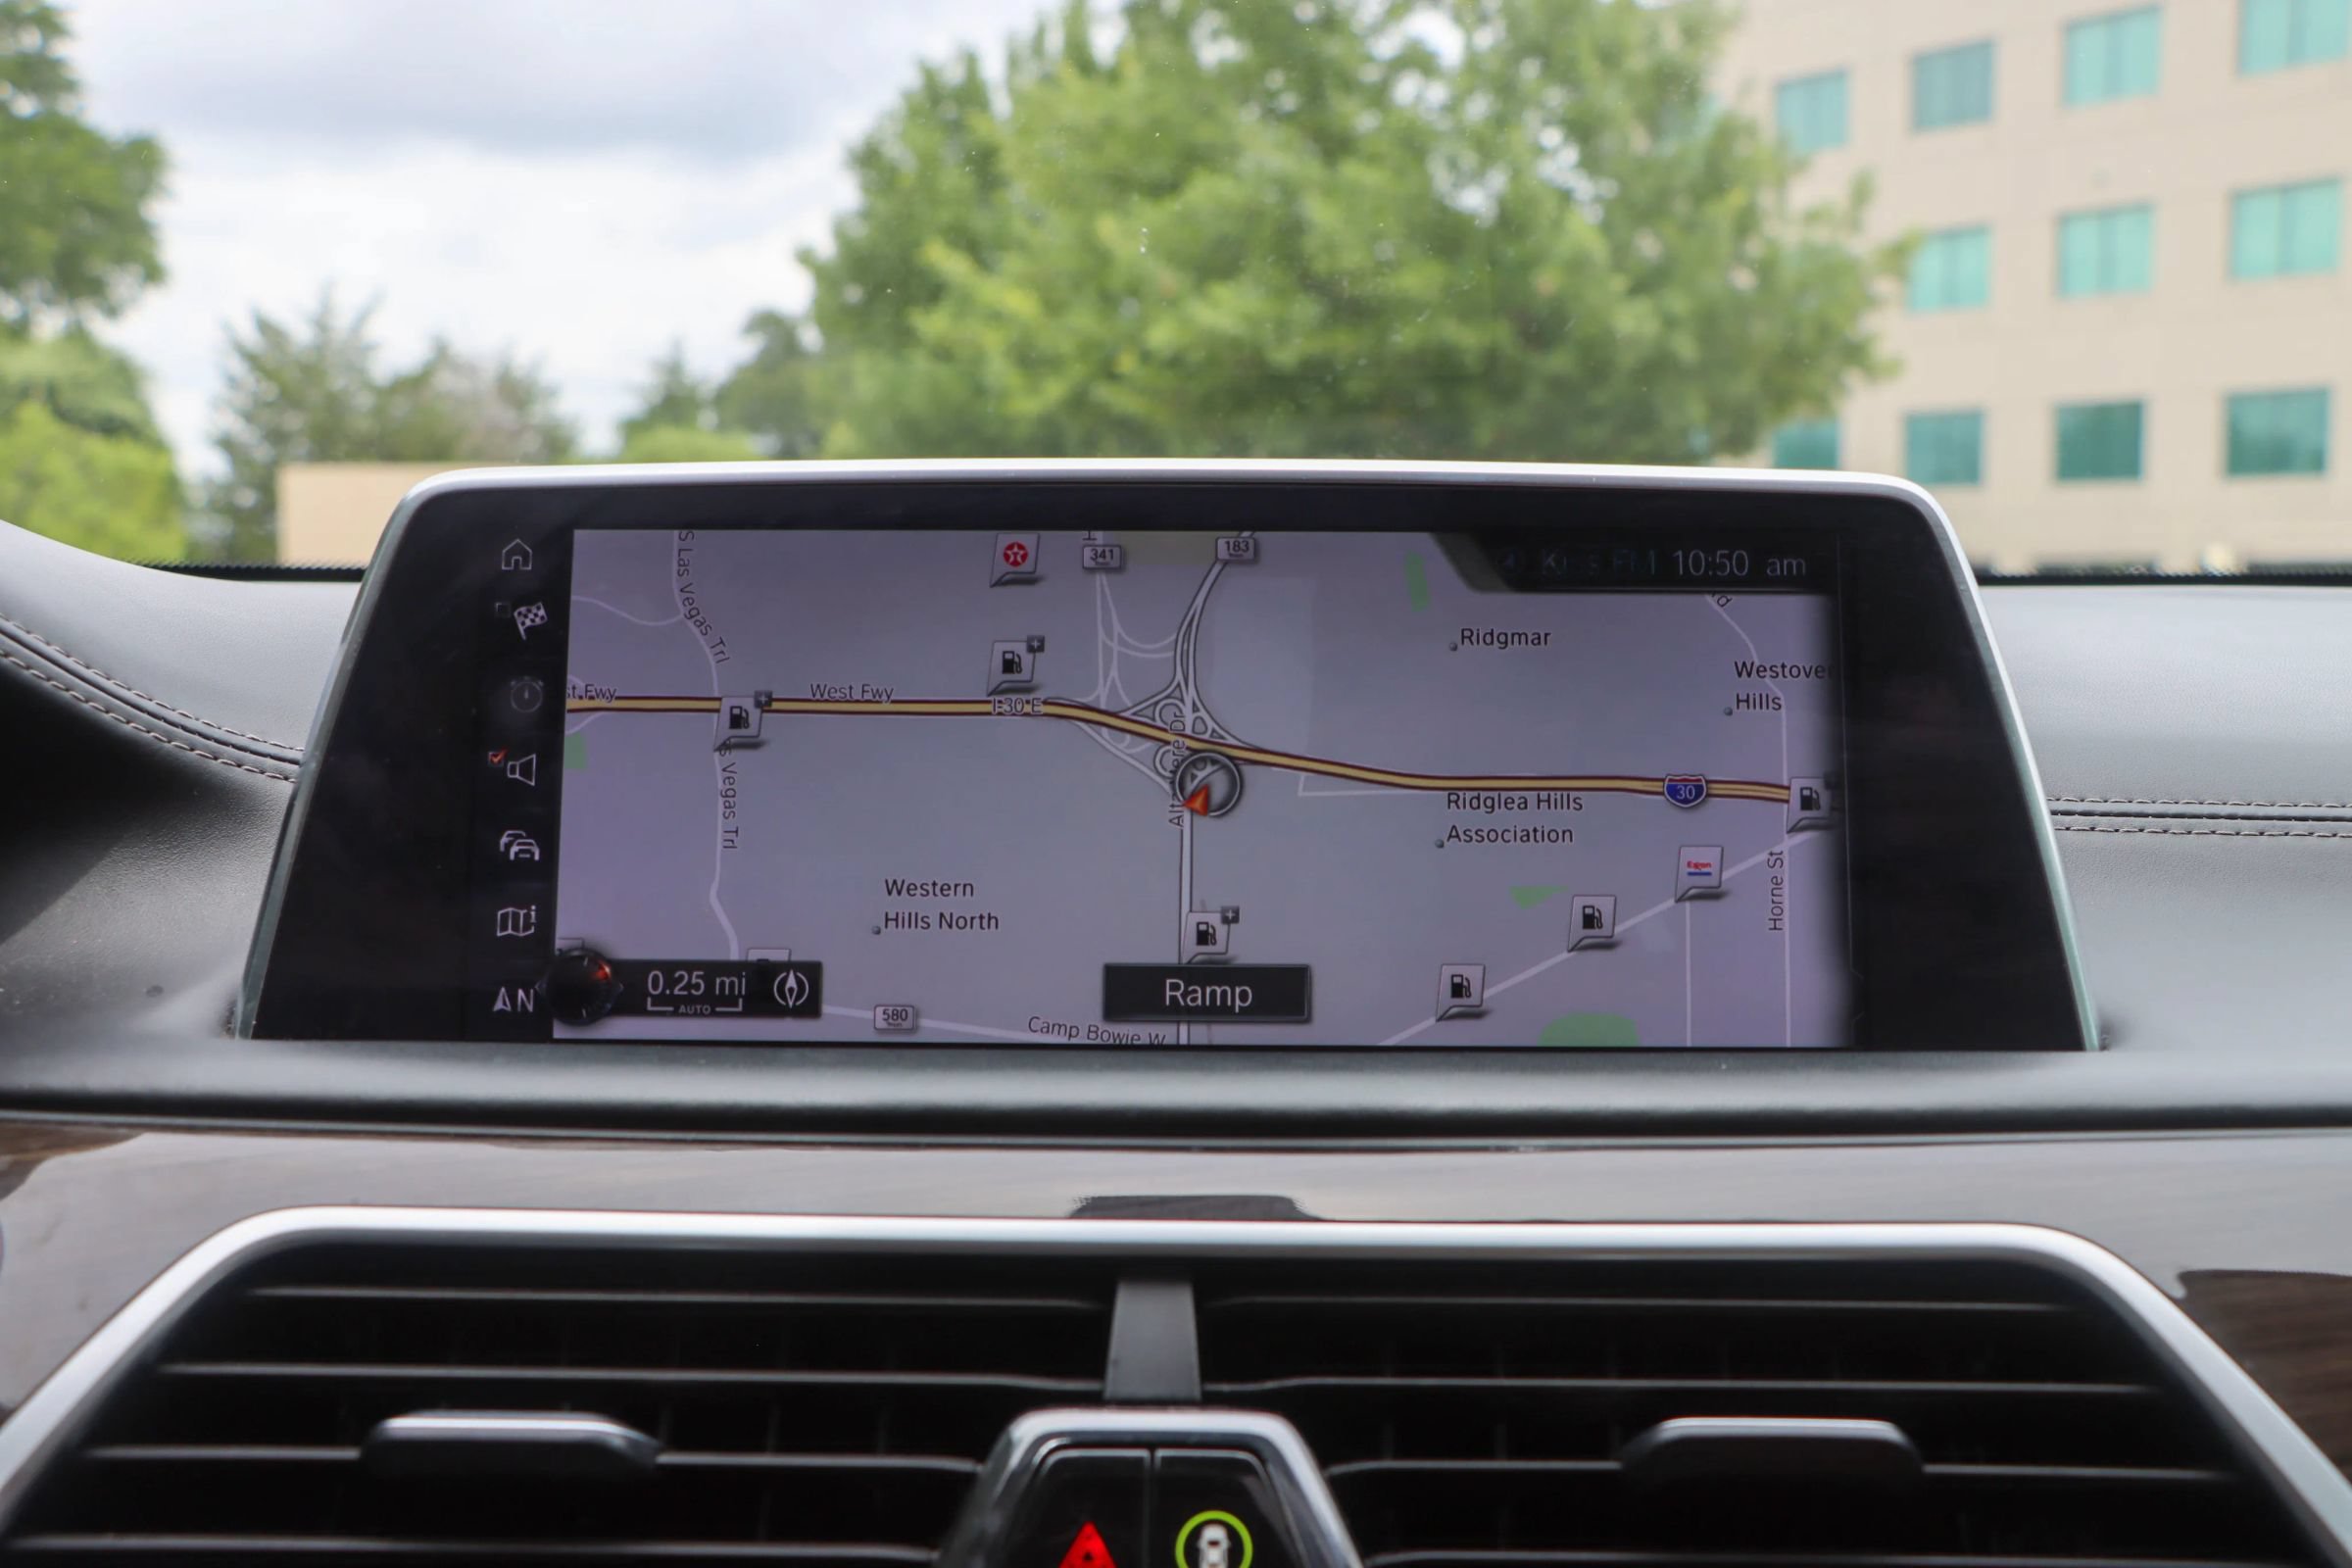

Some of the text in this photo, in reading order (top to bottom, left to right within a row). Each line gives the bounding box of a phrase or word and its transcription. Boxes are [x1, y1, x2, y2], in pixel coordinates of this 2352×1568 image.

[1090, 547, 1115, 562] 341
[1224, 539, 1250, 554] 183
[676, 548, 694, 577] Las
[1672, 549, 1806, 577] 10:50 am
[679, 582, 713, 637] Vegas
[1461, 627, 1550, 649] Ridgmar
[710, 636, 731, 663] Trl
[585, 684, 617, 704] Fwy
[810, 683, 894, 704] West Fwy
[1736, 693, 1782, 710] Hills
[1031, 698, 1042, 714] E
[1169, 711, 1186, 827] Altaere Dr
[720, 762, 737, 819] Vegas
[1677, 786, 1695, 801] 30
[1446, 792, 1583, 815] Ridglea Hills
[723, 826, 738, 849] Trl
[1446, 825, 1573, 843] Association
[885, 878, 974, 898] Western
[1768, 850, 1785, 931] Horne St
[884, 911, 1000, 931] Hills North
[648, 970, 746, 996] 0.25 mi
[516, 987, 534, 1012] N
[1164, 978, 1253, 1013] Ramp
[678, 1004, 711, 1014] AUTO
[882, 1008, 908, 1021] 580
[1028, 1015, 1080, 1041] Camp
[1086, 1023, 1141, 1045] Bowie
